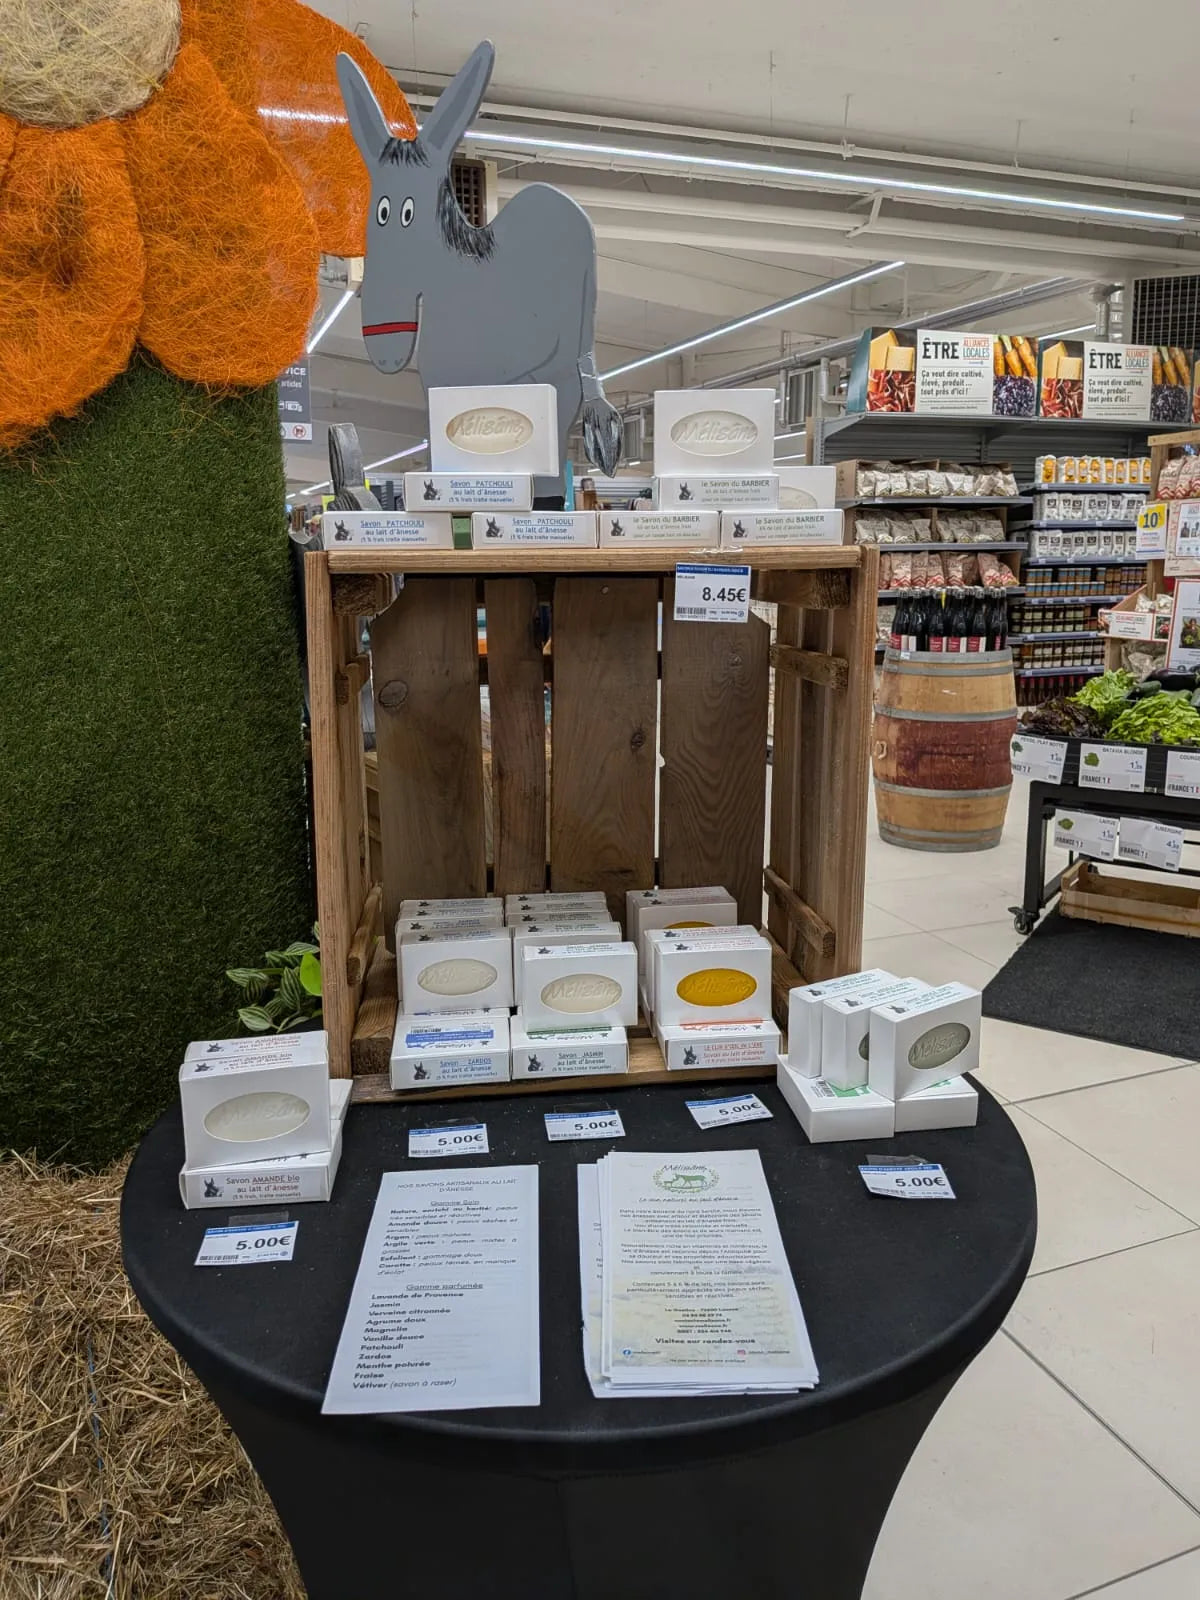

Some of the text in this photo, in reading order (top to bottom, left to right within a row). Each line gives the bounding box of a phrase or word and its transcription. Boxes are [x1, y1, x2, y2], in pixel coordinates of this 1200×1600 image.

[922, 337, 960, 360] ÊTRE
[962, 347, 990, 358] LOCALES
[1089, 348, 1122, 370] ÊTRE
[1125, 357, 1150, 368] LOCALES
[922, 370, 930, 378] Ça
[1088, 378, 1096, 386] Ça
[936, 388, 949, 397] près
[450, 480, 513, 488] Savon PATCHOULI
[360, 520, 424, 528] Savon PATCHOULI
[512, 518, 574, 526] Savon PATCHOULI
[525, 525, 536, 533] lait
[538, 525, 567, 533] d'ânesse
[702, 586, 746, 602] 8.45€
[1082, 774, 1102, 784] FRANCE
[1168, 784, 1189, 792] FRANCE
[1056, 836, 1074, 846] FRANCE
[1120, 847, 1139, 856] FRANCE
[468, 1058, 492, 1066] ZARDOS
[719, 1102, 761, 1116] 5.00€
[574, 1120, 618, 1130] 5.00€
[438, 1134, 484, 1146] 5.00€
[252, 1175, 286, 1185] AMANDE
[287, 1174, 300, 1184] bio
[895, 1177, 946, 1187] 5.00€
[236, 1236, 292, 1250] 5.00€
[394, 1361, 431, 1369] poivrée
[353, 1381, 388, 1389] Vétiver
[390, 1380, 420, 1389] (savon
[430, 1378, 456, 1387] raser)
